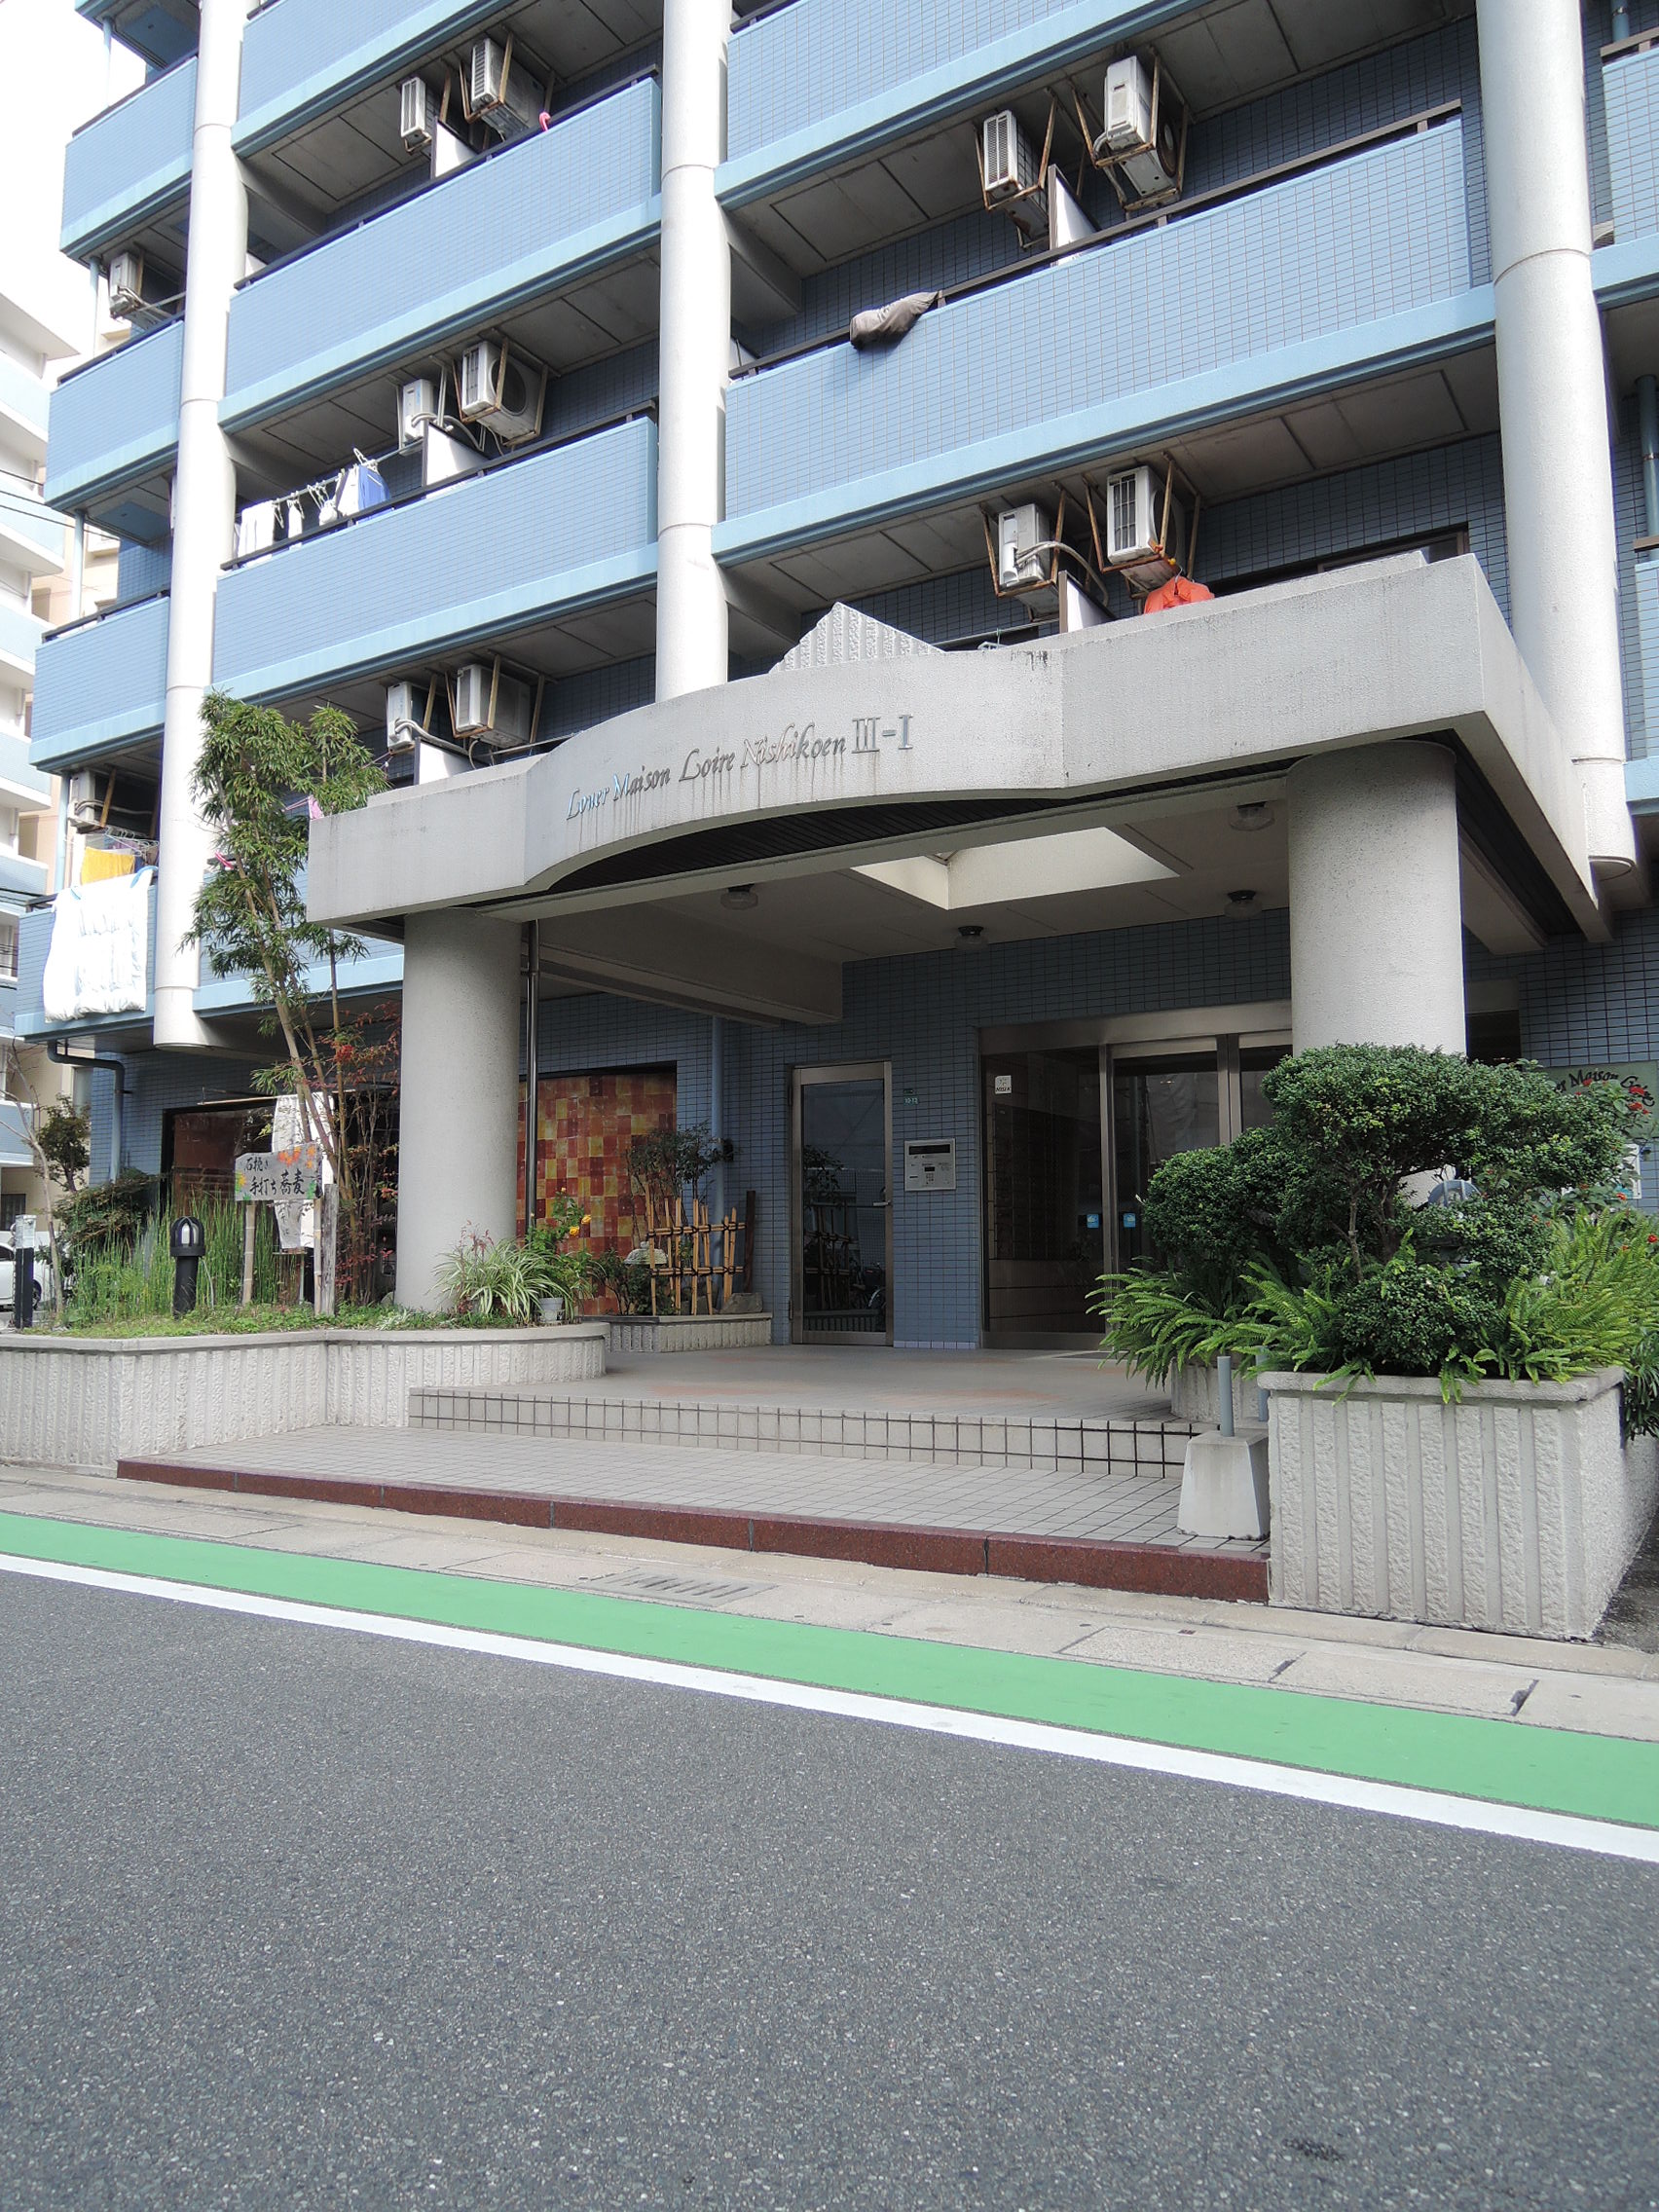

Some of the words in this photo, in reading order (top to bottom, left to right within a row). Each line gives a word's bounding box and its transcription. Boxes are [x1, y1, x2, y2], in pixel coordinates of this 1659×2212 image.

[612, 764, 672, 801] Maison
[678, 746, 736, 782] Loire
[739, 721, 847, 767] Nishikoen
[1568, 1069, 1618, 1088] Maison
[249, 1167, 305, 1196] 手打ち蕎麦
